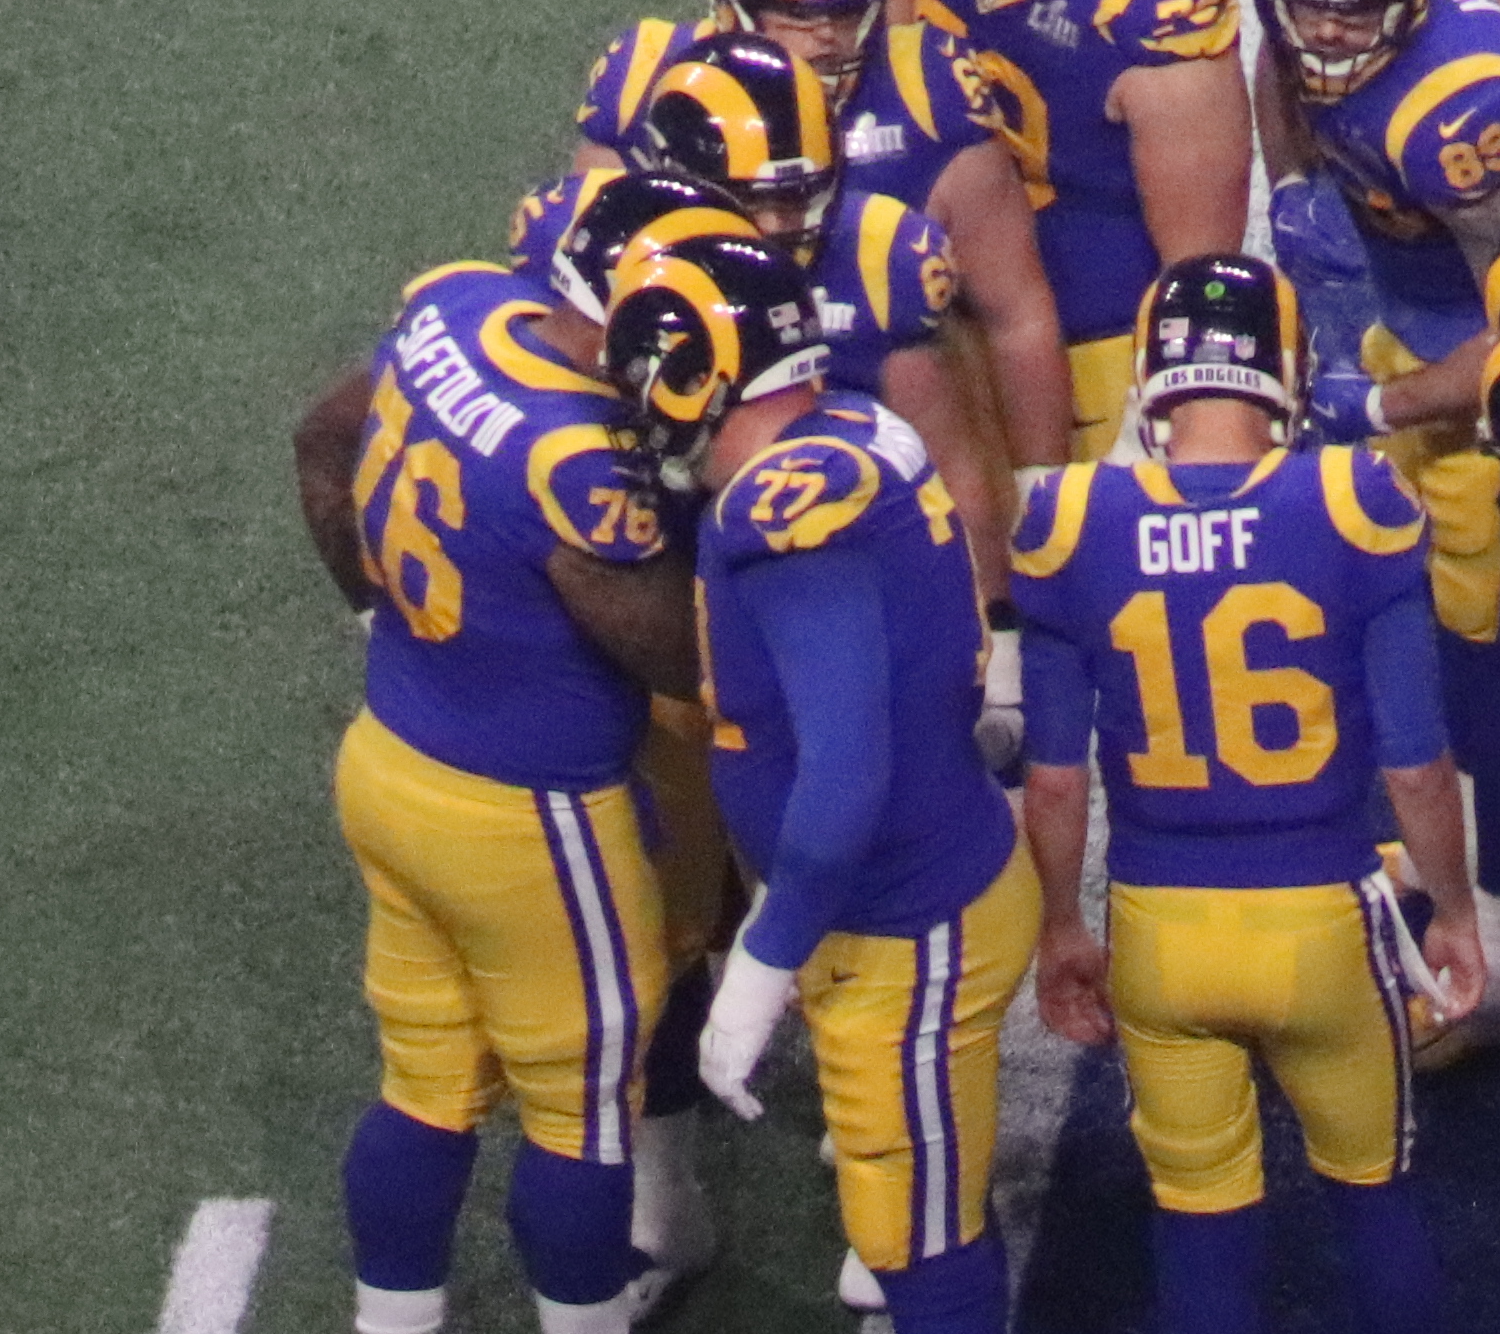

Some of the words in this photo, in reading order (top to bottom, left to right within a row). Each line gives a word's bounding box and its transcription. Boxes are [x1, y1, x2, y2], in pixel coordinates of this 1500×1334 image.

[396, 303, 502, 439] SAFFOLD
[469, 401, 526, 458] III
[352, 362, 464, 643] 76
[588, 487, 657, 544] 76
[750, 469, 826, 522] 77
[1138, 506, 1260, 576] GOFF
[1109, 580, 1339, 790] 16
